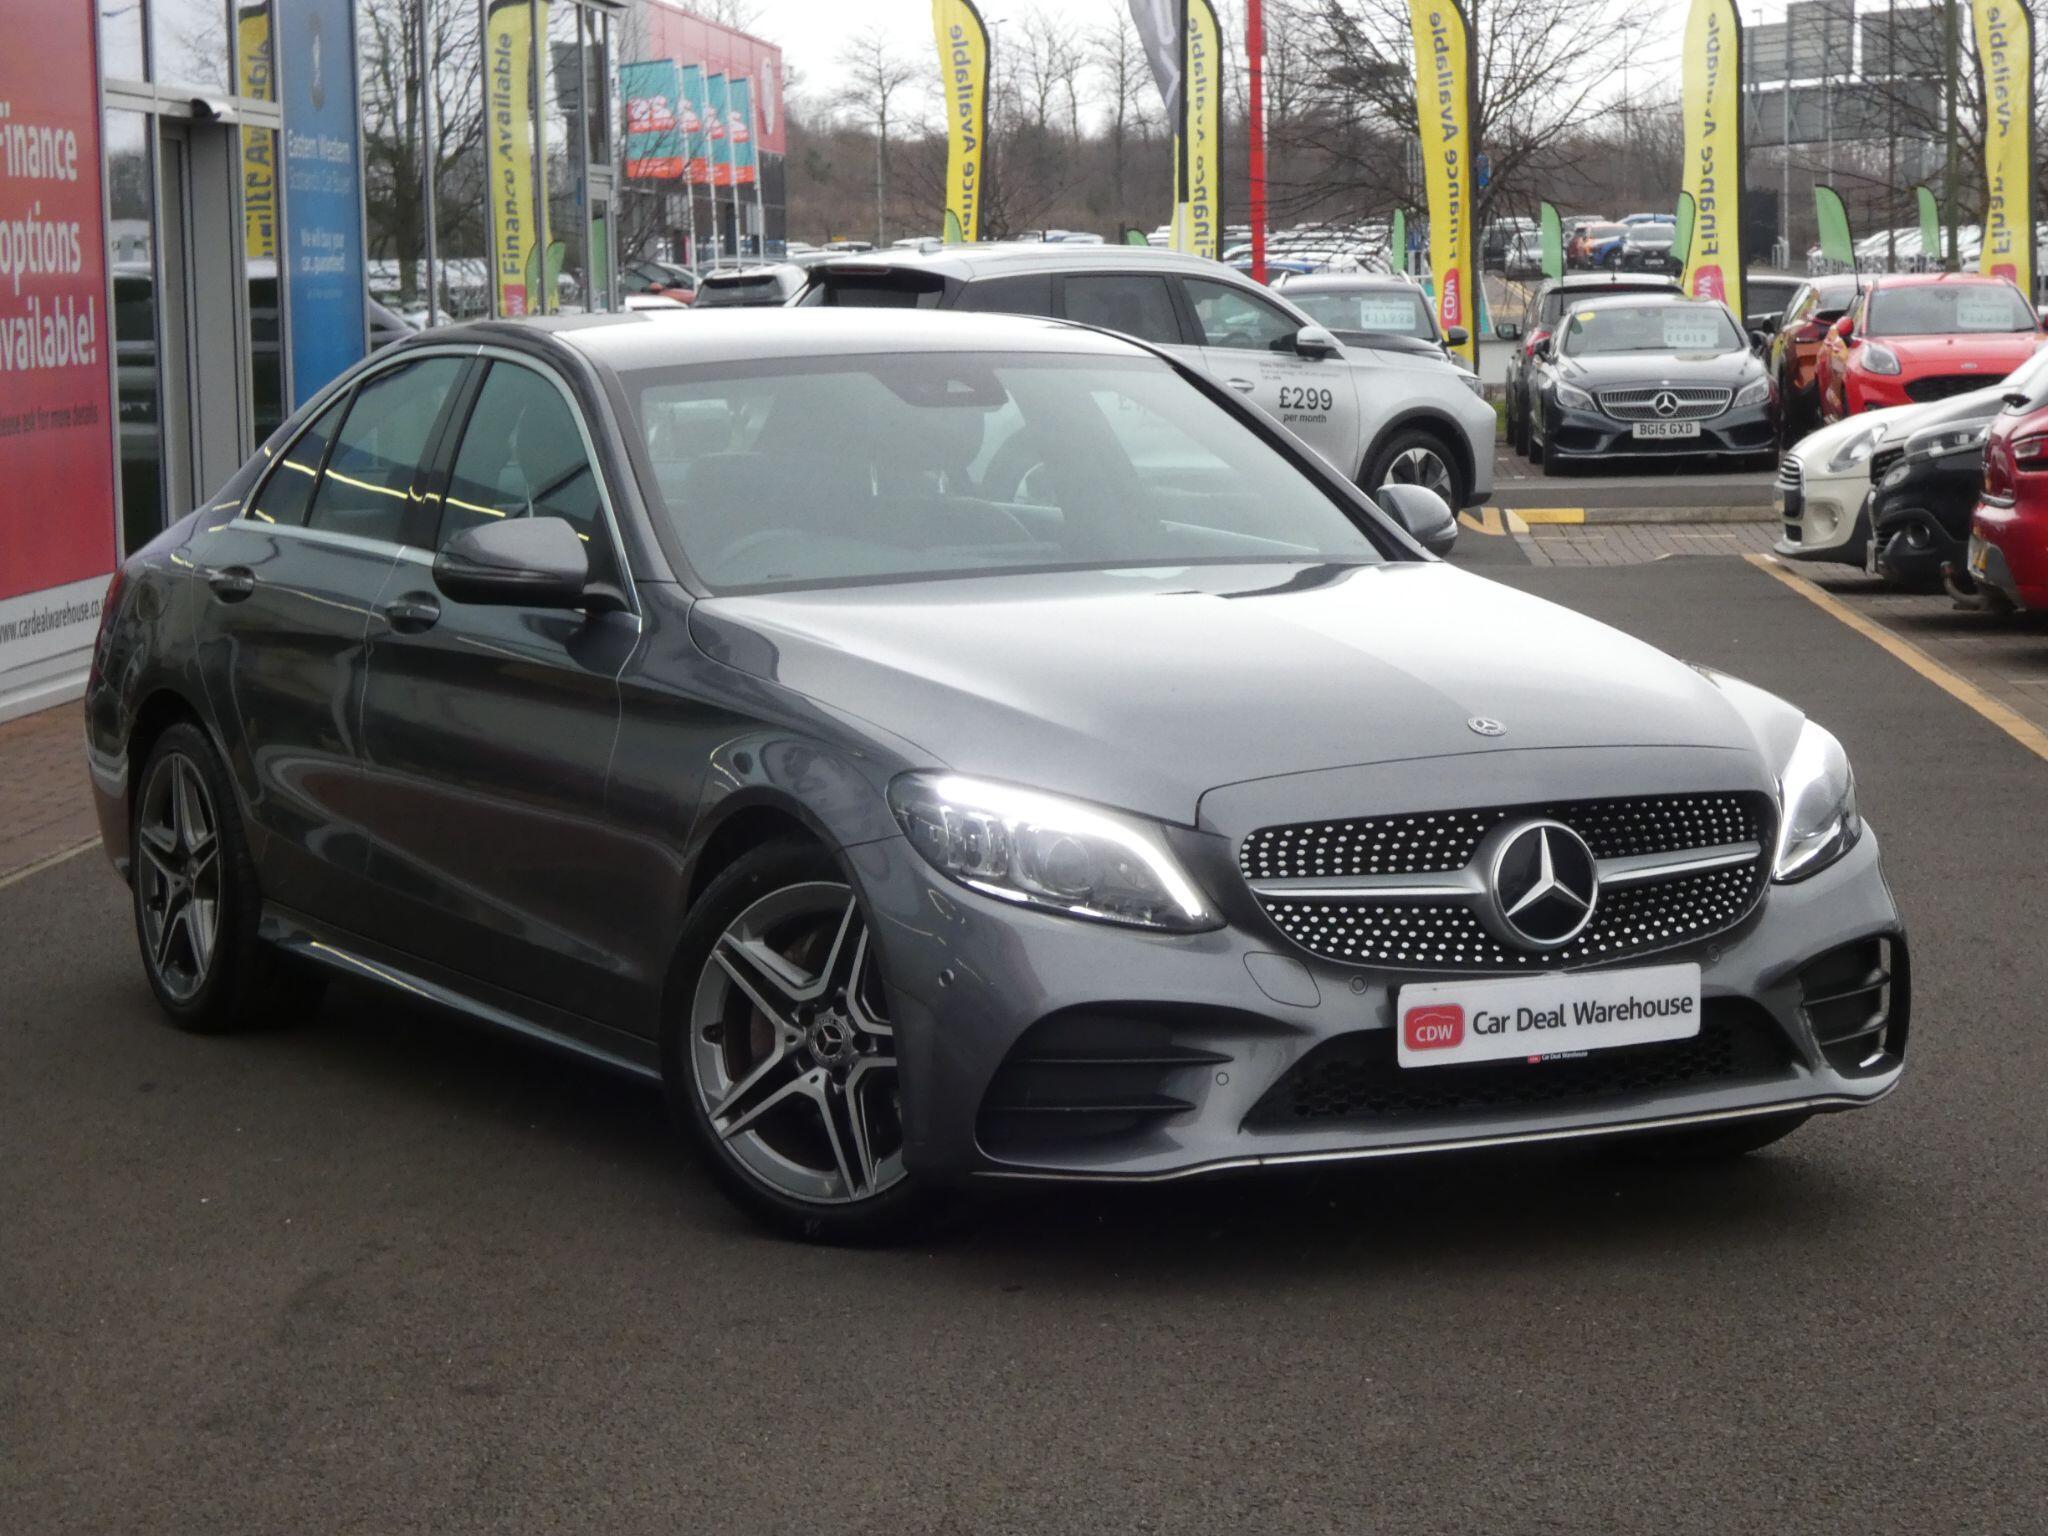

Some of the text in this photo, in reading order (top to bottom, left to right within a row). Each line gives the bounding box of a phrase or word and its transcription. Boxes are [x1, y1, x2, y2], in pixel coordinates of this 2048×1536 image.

[0, 101, 78, 182] inance
[493, 33, 521, 275] Finance Available
[0, 201, 81, 296] options
[0, 296, 96, 371] vailable!
[1279, 386, 1333, 411] £299
[1283, 414, 1327, 423] per month
[1640, 423, 1693, 435] BG15 GXD
[1415, 996, 1693, 1042] CDW Car Deal Warehouse
